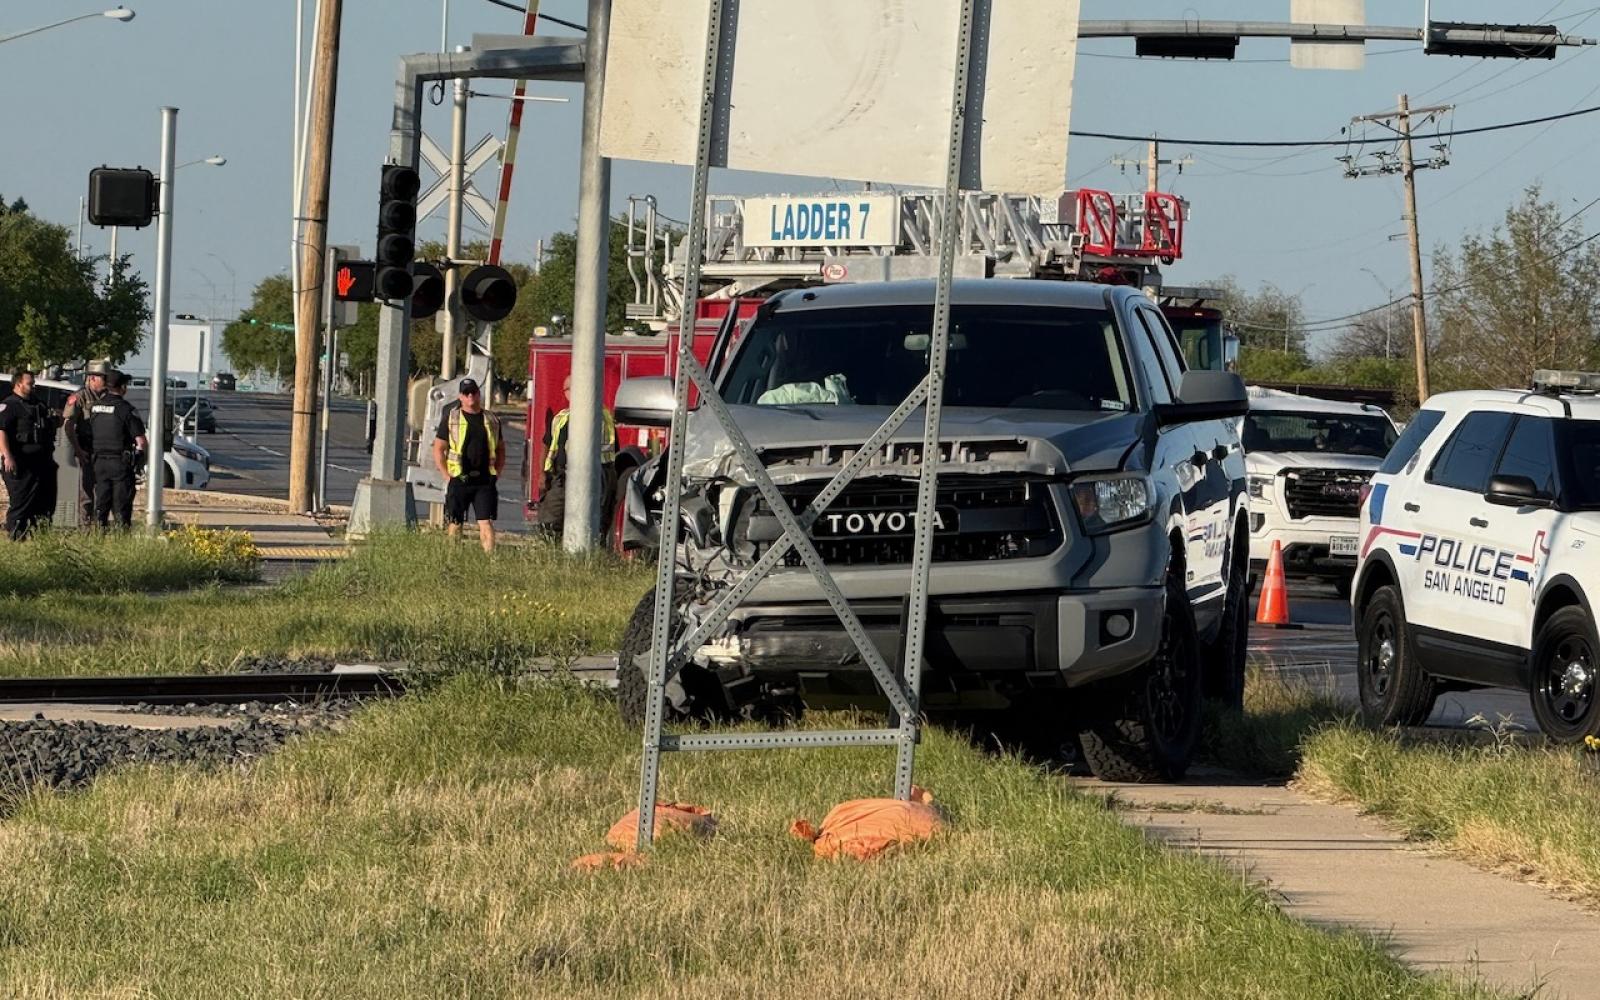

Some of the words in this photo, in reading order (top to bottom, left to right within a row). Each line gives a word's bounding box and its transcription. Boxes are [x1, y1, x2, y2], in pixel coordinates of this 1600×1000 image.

[771, 203, 850, 240] LADDER
[859, 203, 870, 240] 7
[1416, 535, 1515, 580] POLICE
[1424, 570, 1450, 592] SAN
[1453, 576, 1506, 605] ANGELO
